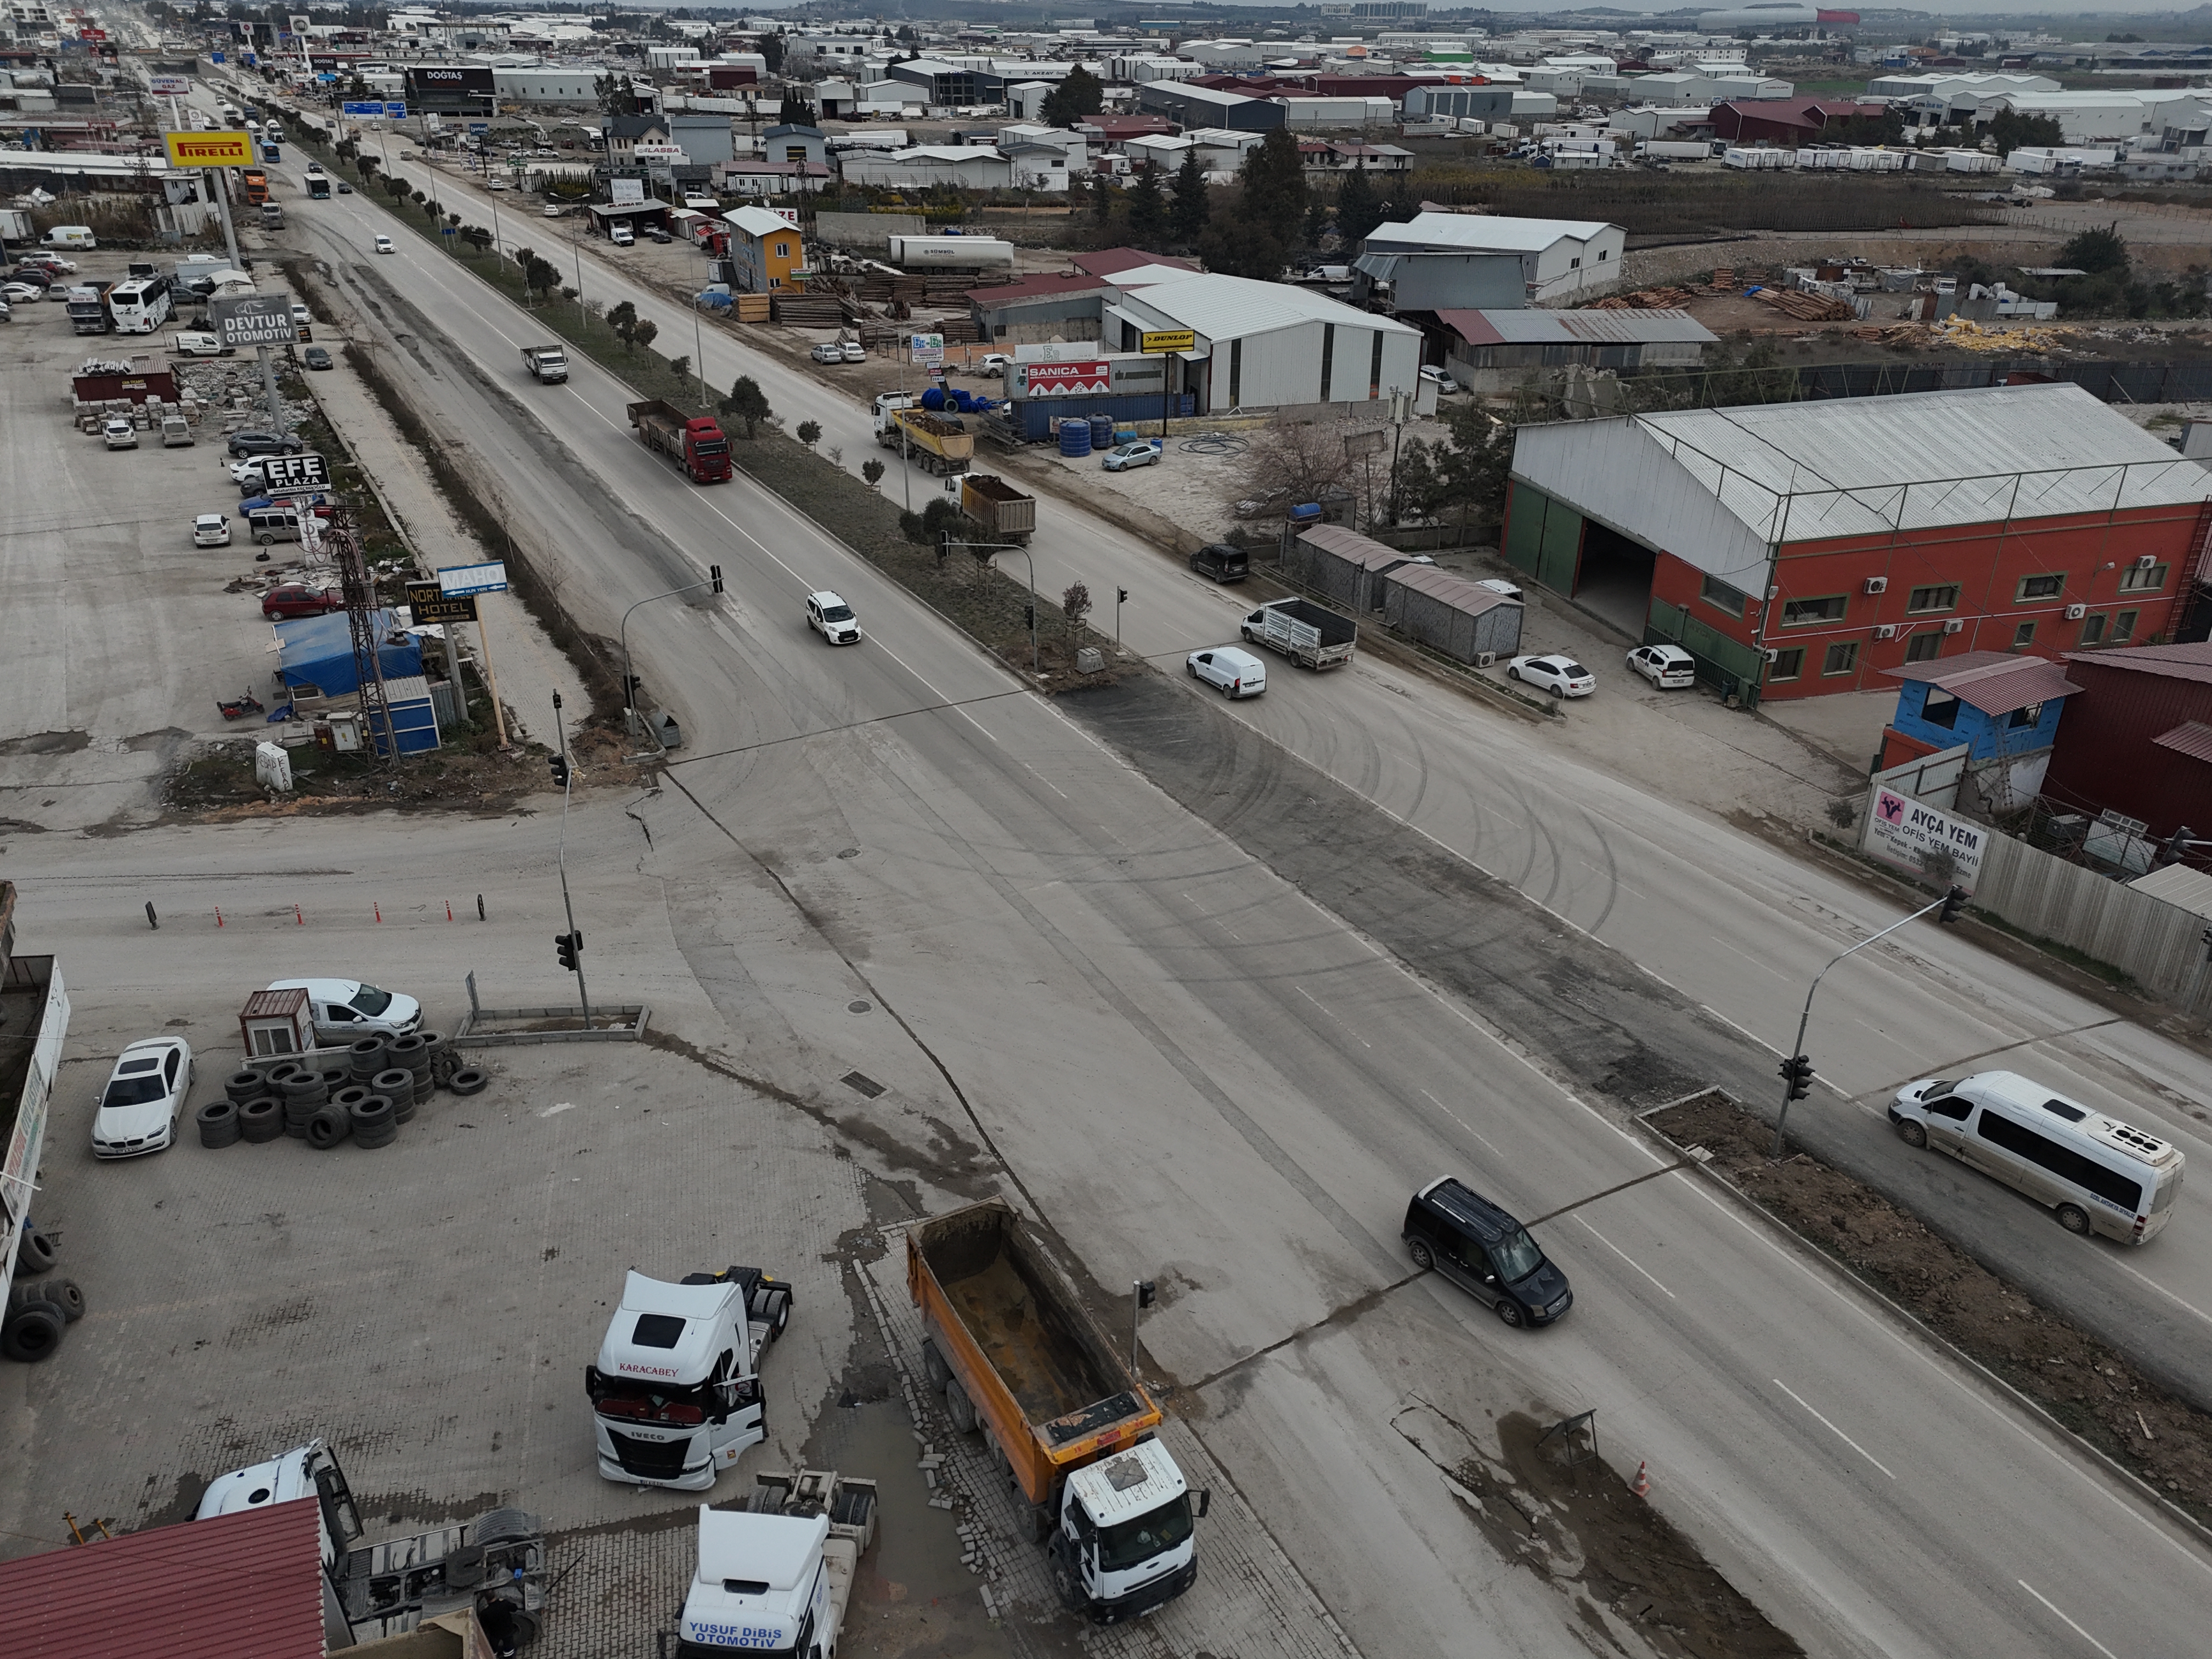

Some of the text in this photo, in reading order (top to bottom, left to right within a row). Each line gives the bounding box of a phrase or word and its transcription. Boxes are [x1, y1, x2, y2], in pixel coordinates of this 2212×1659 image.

[427, 70, 462, 81] DOĞTAŞ
[177, 142, 243, 156] PIRELLI
[224, 314, 287, 331] DEVTUR
[226, 328, 291, 343] OTOMOTİV
[1029, 367, 1079, 376] SANICA
[267, 458, 321, 479] EFE
[275, 476, 319, 487] PLAZA
[441, 568, 500, 589] MAHO
[418, 603, 469, 615] HOTEL
[257, 752, 276, 771] KEBAP
[278, 758, 289, 790] KEBAP
[1875, 817, 1900, 832] OFİS YEM
[1910, 808, 1978, 850] AYÇA YEM
[1874, 827, 1885, 838] Yem
[1890, 835, 1908, 849] Kepek
[1956, 866, 1972, 878] Ezme
[1902, 826, 1979, 867] OFİS YEM BAYİİ
[2101, 1198, 2119, 1211] ANTAKYA
[619, 1363, 679, 1377] KARACABEY
[631, 1431, 665, 1441] IVECO
[690, 1622, 738, 1635] YUSUF
[695, 1633, 775, 1647] OTOMOTİV
